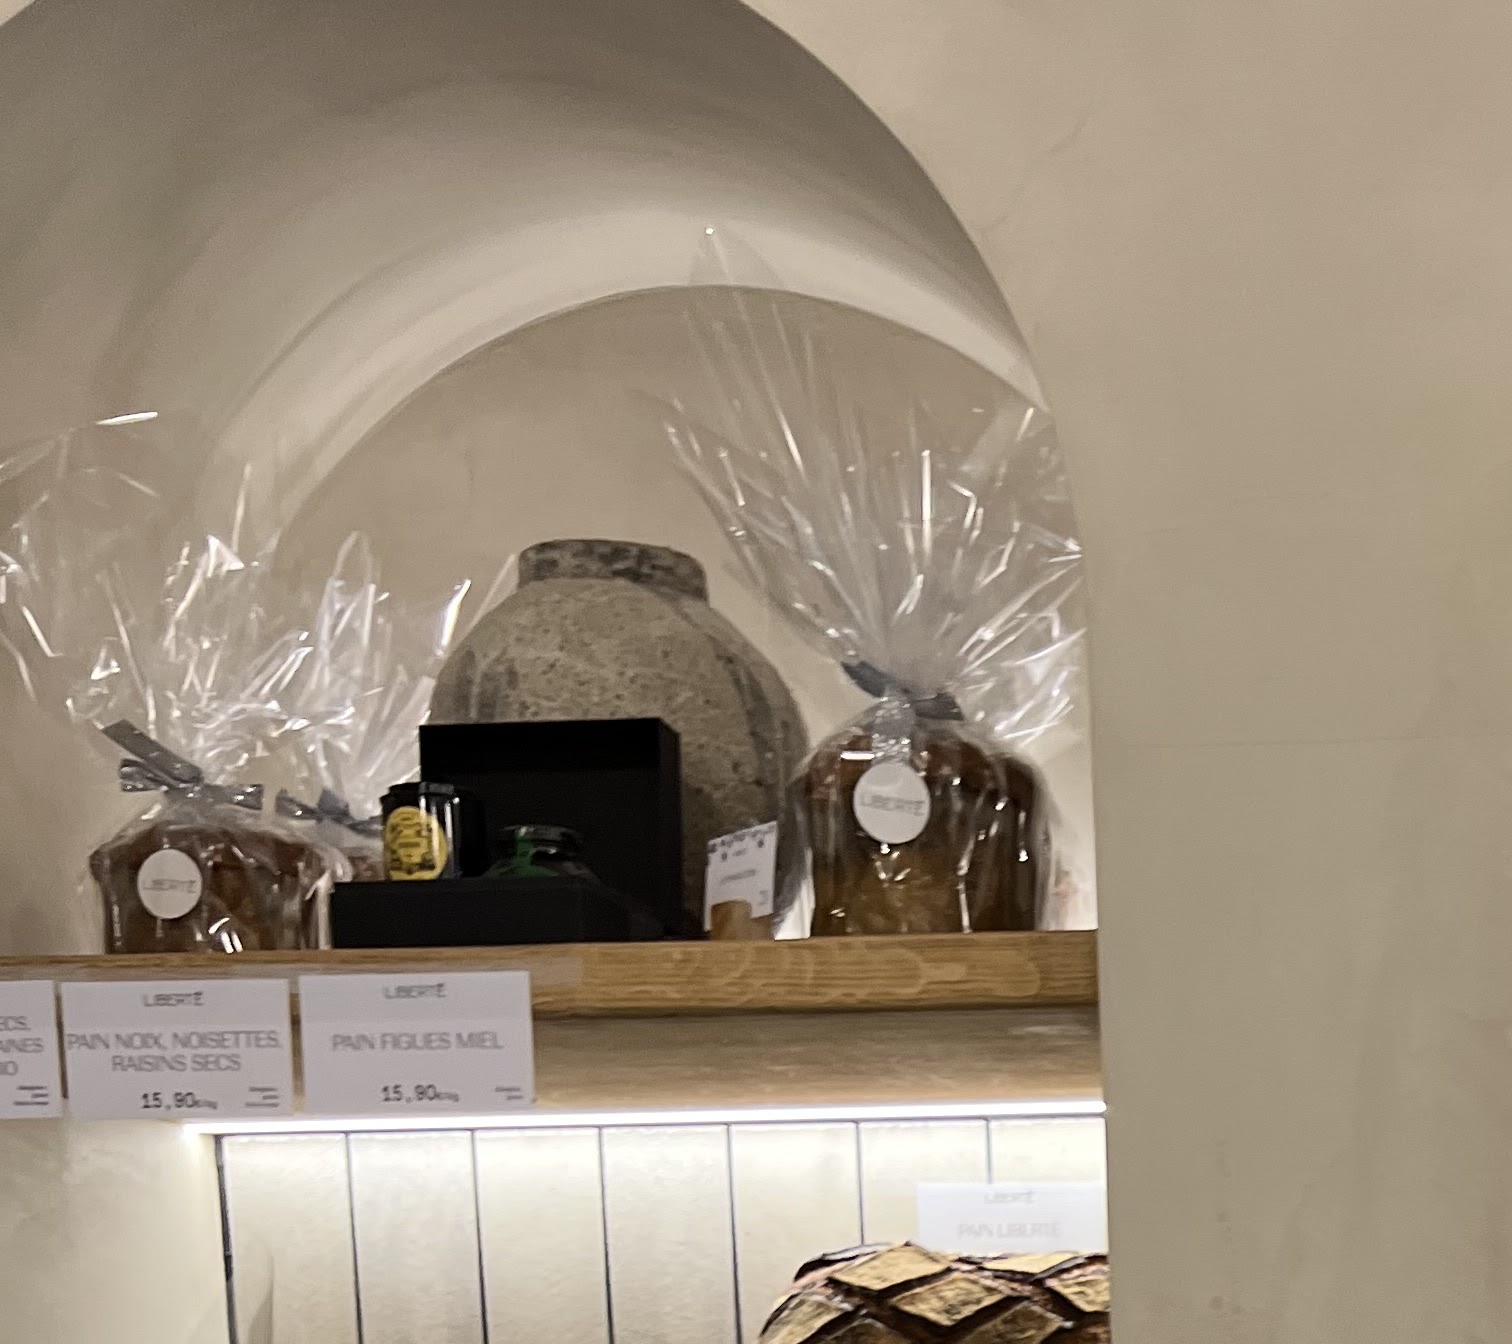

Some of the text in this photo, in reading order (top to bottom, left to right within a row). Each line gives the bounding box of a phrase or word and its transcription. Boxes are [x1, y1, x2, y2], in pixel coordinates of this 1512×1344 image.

[67, 1033, 110, 1050] PAIN
[331, 1031, 504, 1051] PAIN FIGUES MIEL
[112, 1053, 242, 1072] RAISINS SECS
